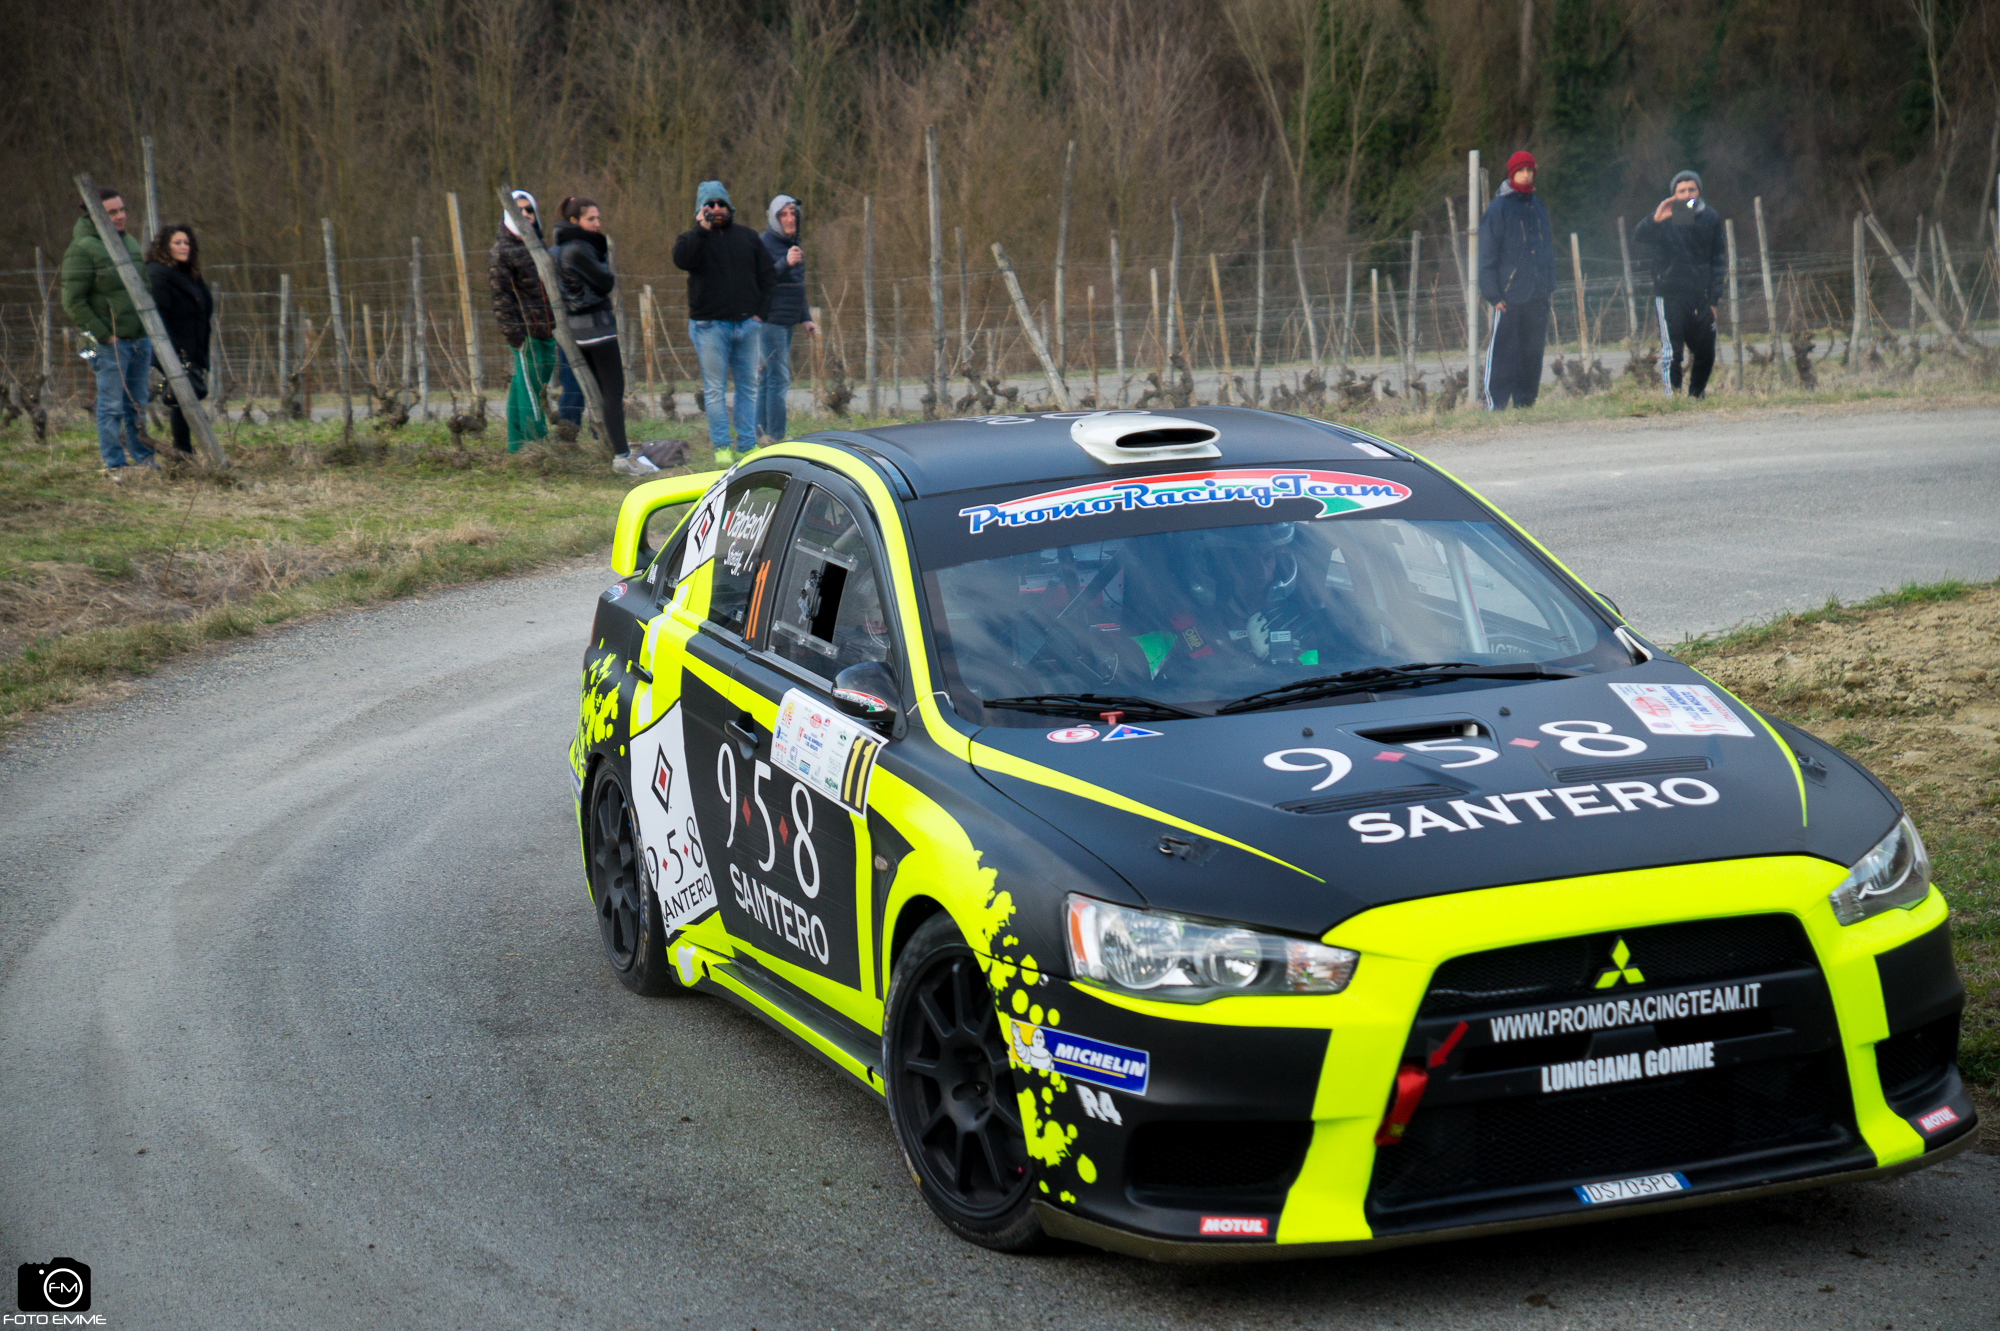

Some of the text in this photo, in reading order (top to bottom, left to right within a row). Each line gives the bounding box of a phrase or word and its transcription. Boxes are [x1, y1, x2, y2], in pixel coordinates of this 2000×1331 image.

[959, 474, 1404, 534] PromoRacingTeam
[745, 559, 771, 641] 11
[843, 735, 878, 809] 11
[1347, 777, 1721, 844] SANTERO
[663, 872, 712, 928] ANTERO
[730, 863, 830, 966] SANTERO
[1490, 983, 1762, 1042] WWW.PROMORACINGTEAM.IT
[1054, 1042, 1147, 1078] MICHELIN
[1541, 1041, 1715, 1093] LUNIGIANA GOMME
[1075, 1083, 1123, 1126] R4
[1921, 1108, 1956, 1130] MOTUL
[1586, 1174, 1678, 1201] DS703PC
[1202, 1218, 1264, 1233] MOTUL
